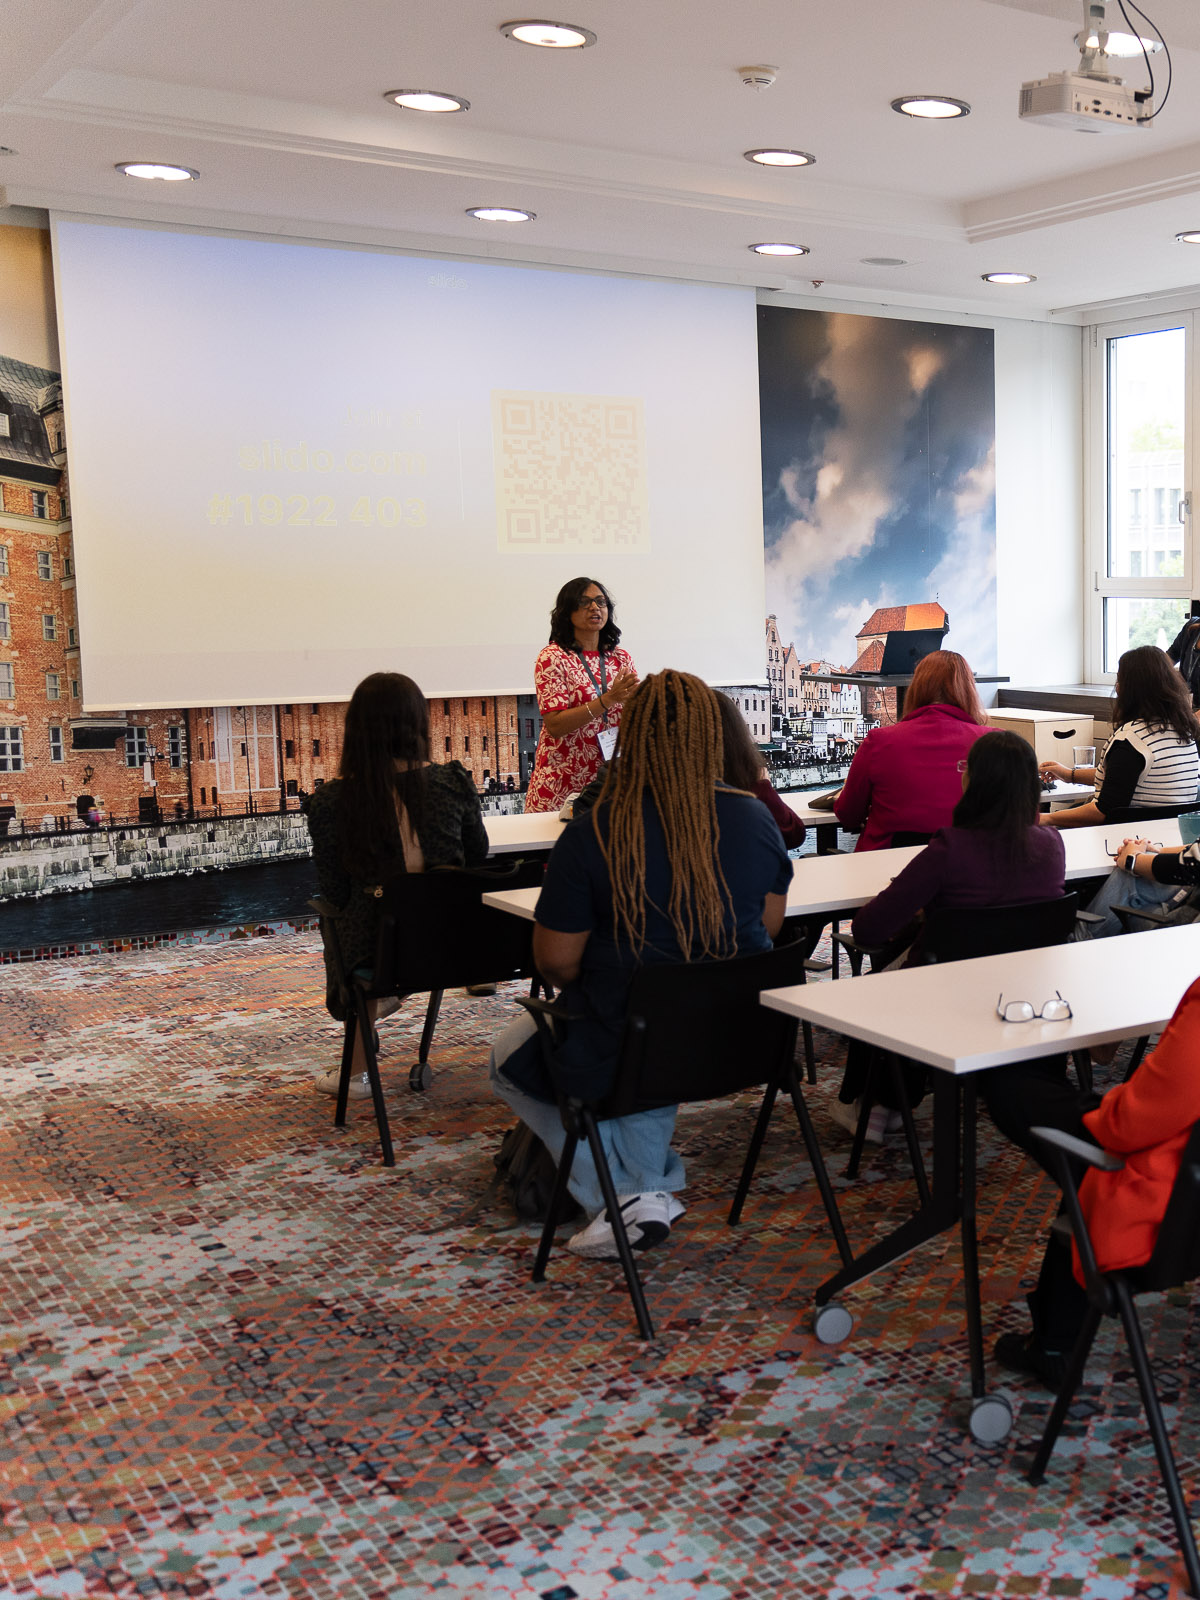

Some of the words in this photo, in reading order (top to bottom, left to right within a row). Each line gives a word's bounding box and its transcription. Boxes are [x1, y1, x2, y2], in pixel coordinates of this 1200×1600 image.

[239, 439, 428, 476] slido.com
[207, 492, 337, 526] #1922
[349, 495, 429, 528] 403
